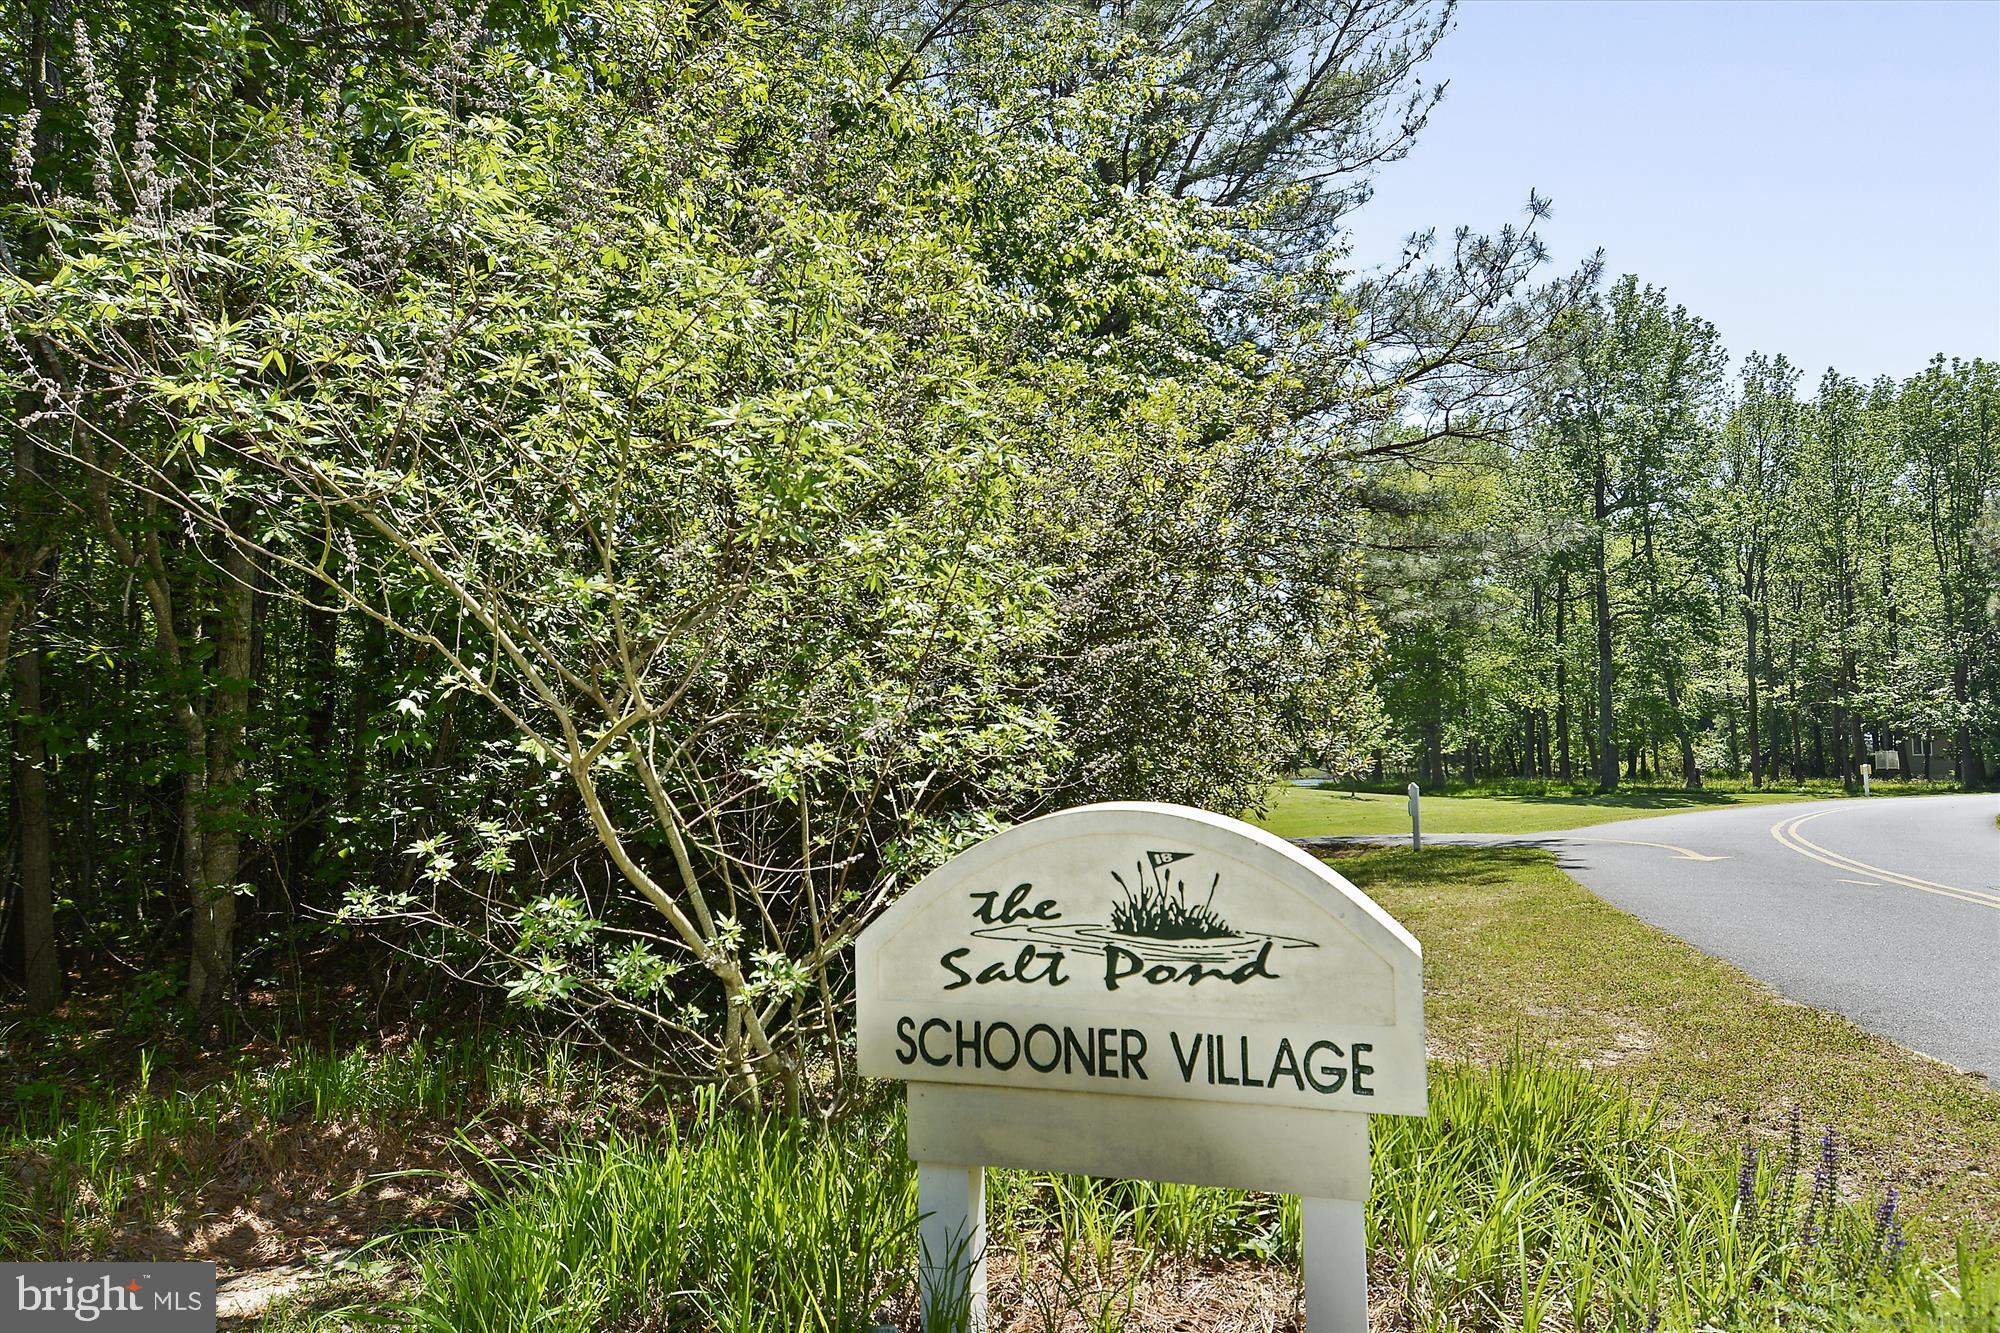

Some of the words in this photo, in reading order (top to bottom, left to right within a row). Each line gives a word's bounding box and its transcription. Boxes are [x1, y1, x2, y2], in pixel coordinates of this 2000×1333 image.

[1153, 852, 1174, 865] 18
[969, 883, 1062, 923] the
[940, 945, 1070, 991] Salt
[1102, 941, 1280, 991] Pond
[895, 1017, 1149, 1081] SCHOONER
[1169, 1031, 1375, 1096] VILLAGE
